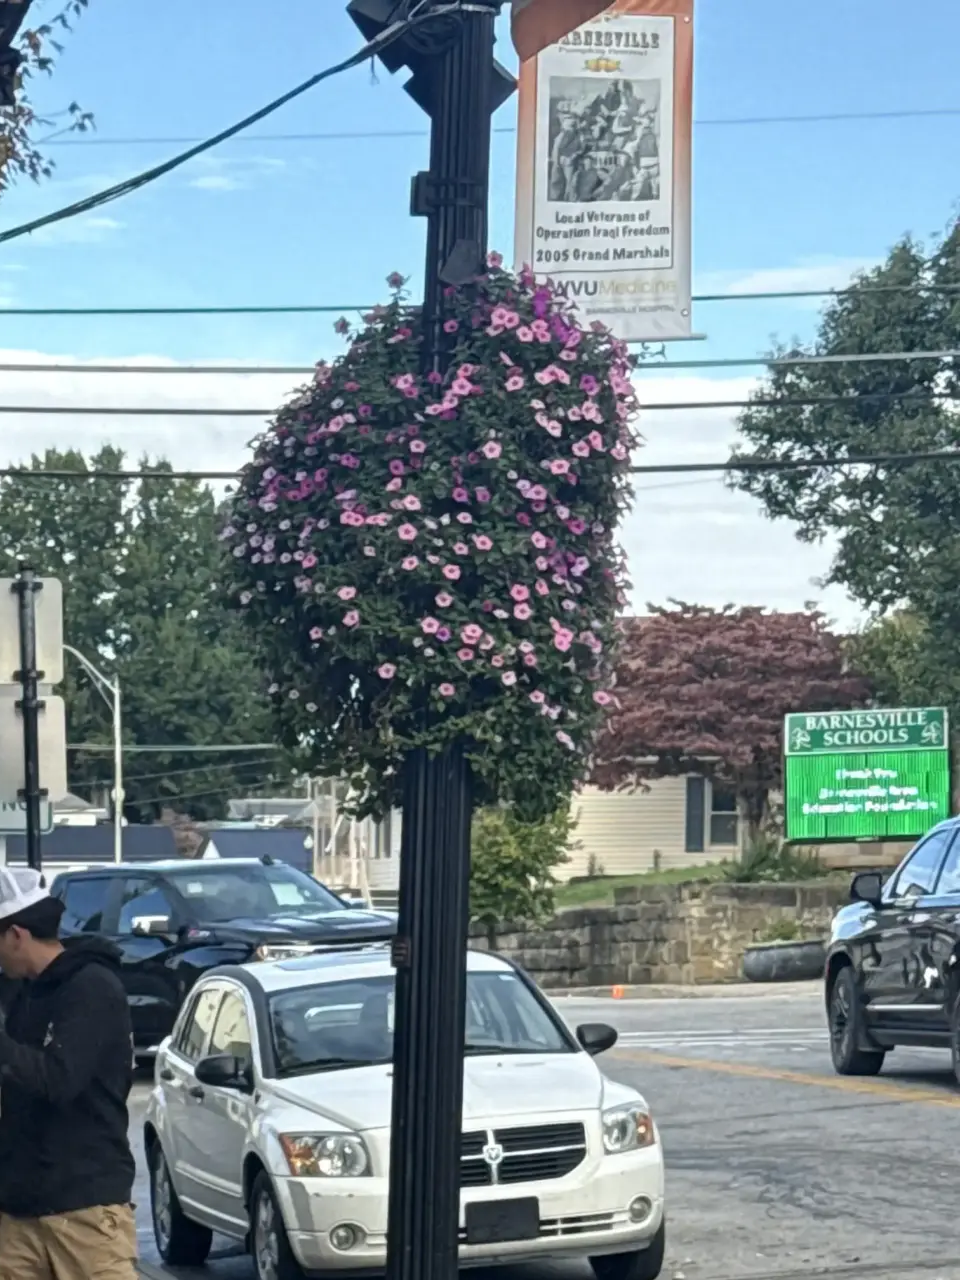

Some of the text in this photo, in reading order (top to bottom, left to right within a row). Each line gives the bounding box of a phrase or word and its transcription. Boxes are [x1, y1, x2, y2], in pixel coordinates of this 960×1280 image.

[560, 30, 660, 49] ARNESVILLE
[555, 210, 651, 224] Local Veterans of
[536, 225, 670, 241] Operation Iraqi Freedom
[536, 245, 670, 262] 2005 Grand Marshals
[806, 711, 928, 730] BARNESVILLE
[823, 728, 909, 746] SCHOOLS
